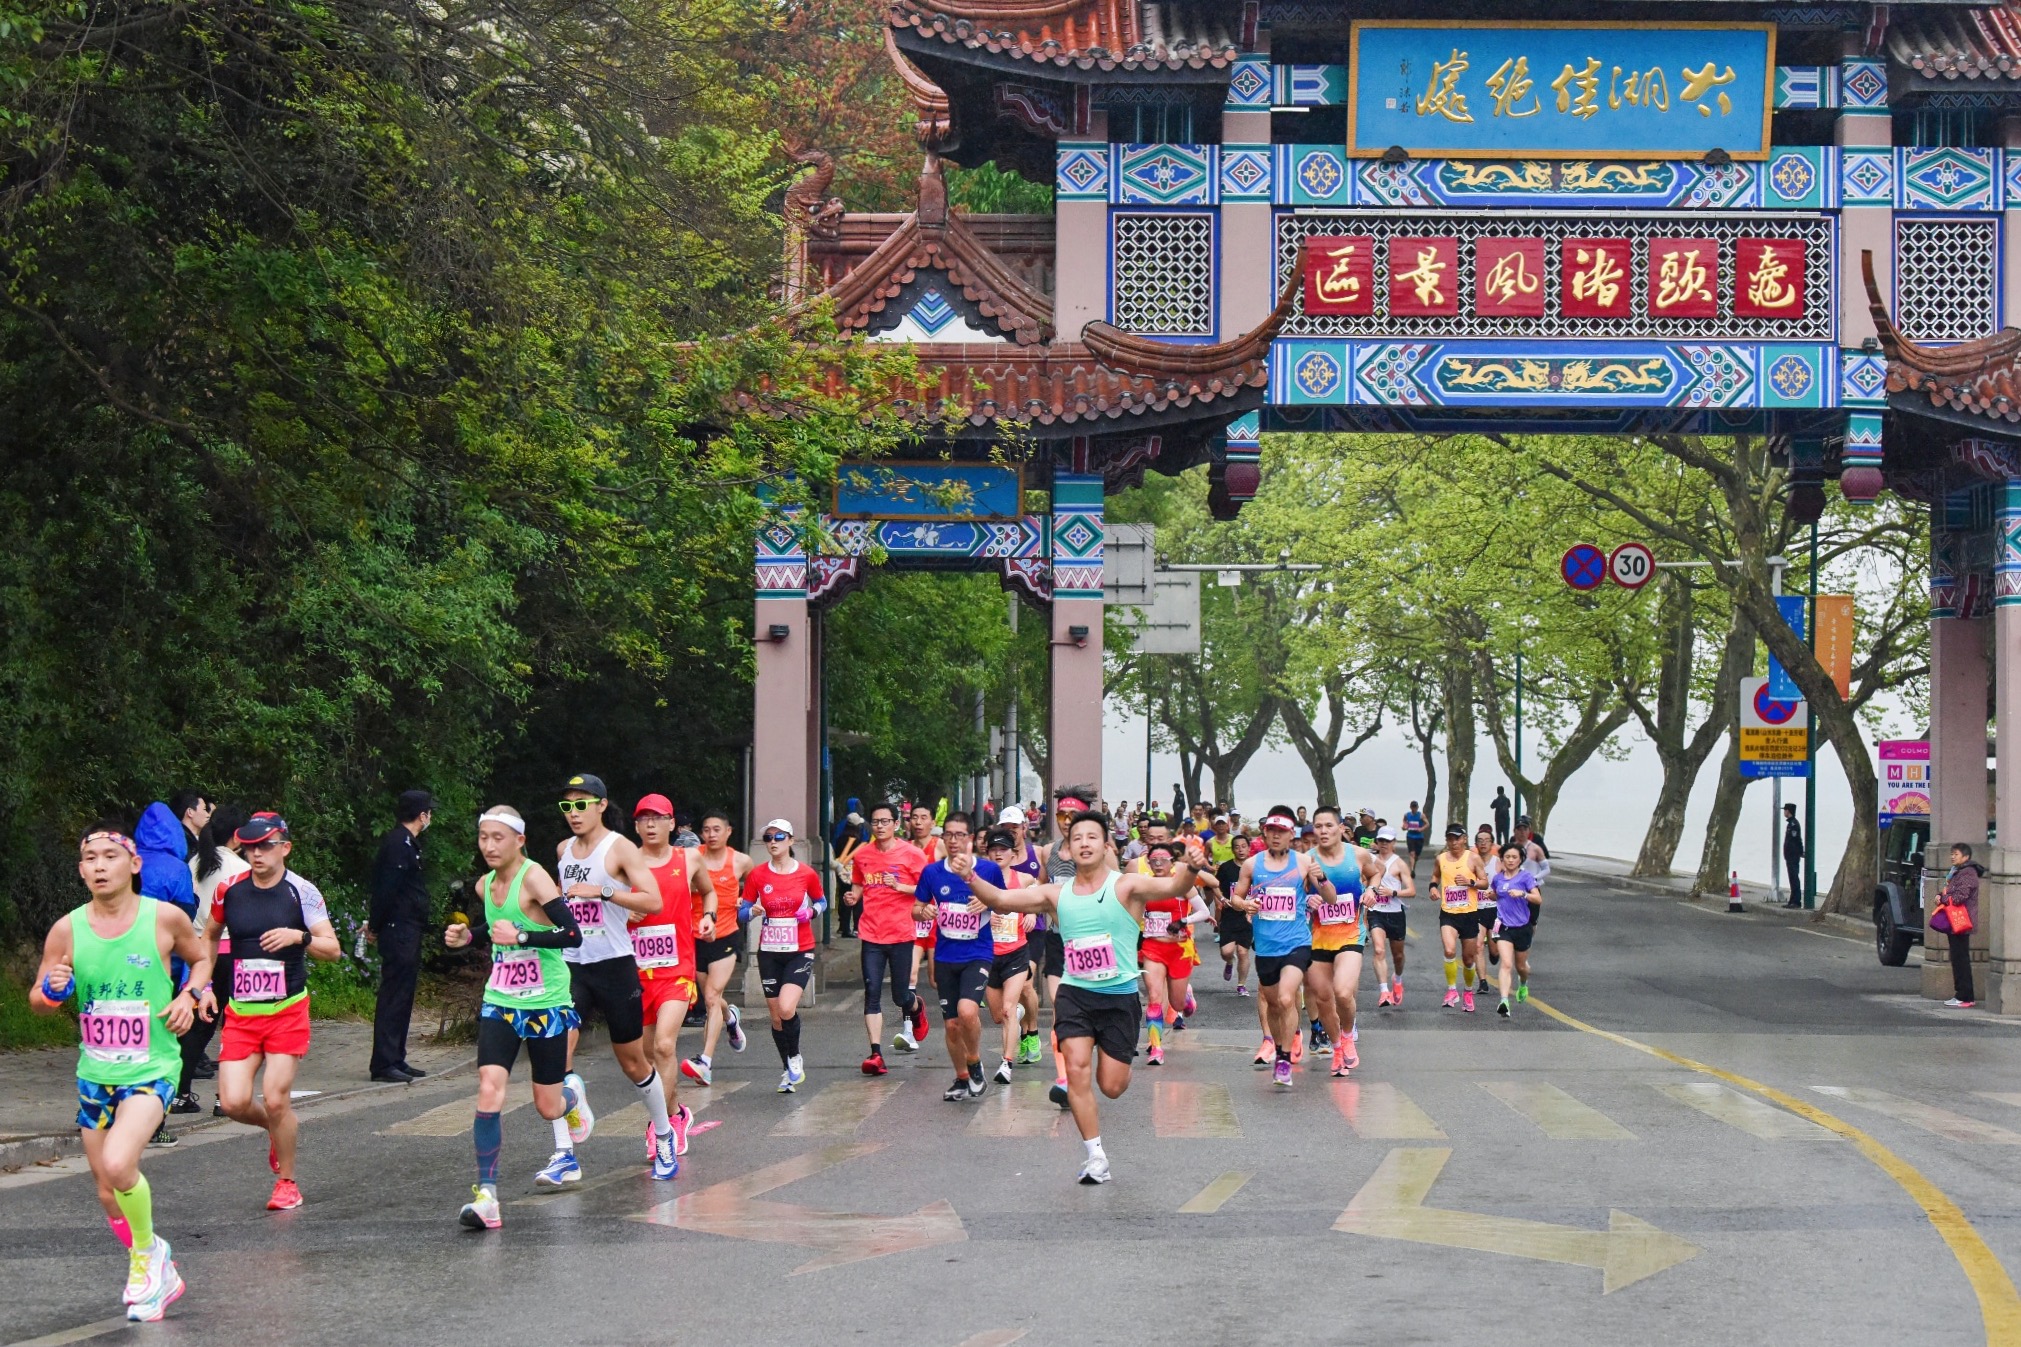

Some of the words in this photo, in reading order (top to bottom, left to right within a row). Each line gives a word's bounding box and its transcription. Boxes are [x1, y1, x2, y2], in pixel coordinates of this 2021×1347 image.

[1619, 554, 1646, 577] 30
[1259, 895, 1294, 911] 10779
[1445, 890, 1467, 902] 22099
[941, 911, 977, 931] 24692
[1320, 902, 1353, 919] 16901
[763, 926, 795, 942] 33051
[632, 936, 674, 957] 10989
[1068, 946, 1110, 971] 13891
[235, 972, 281, 993] 26027
[496, 961, 539, 985] 17293
[83, 1016, 144, 1046] 13109
